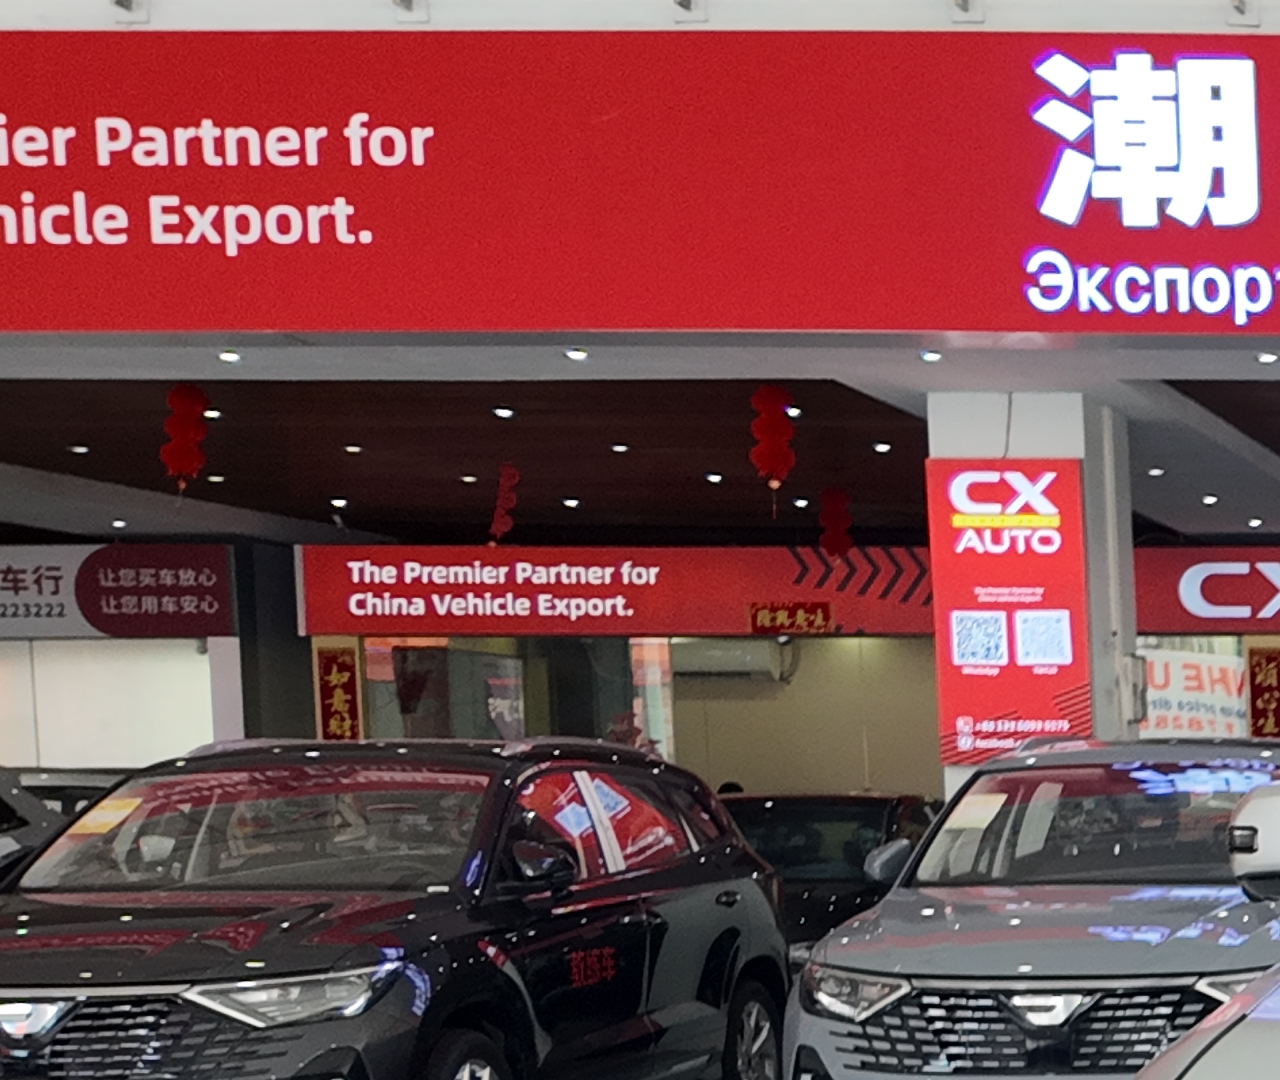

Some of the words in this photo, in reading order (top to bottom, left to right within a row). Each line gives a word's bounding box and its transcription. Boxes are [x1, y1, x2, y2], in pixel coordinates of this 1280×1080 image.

[95, 116, 329, 167] Partner
[343, 112, 435, 167] for
[149, 194, 373, 257] Export.
[948, 469, 1060, 514] CX
[954, 528, 1062, 554] AUTO
[347, 561, 397, 585] The
[403, 561, 509, 585] Premier
[515, 562, 616, 585] Partner
[620, 560, 661, 585] for
[348, 592, 426, 617] China
[432, 592, 531, 617] Vehicle
[537, 593, 635, 621] Export.
